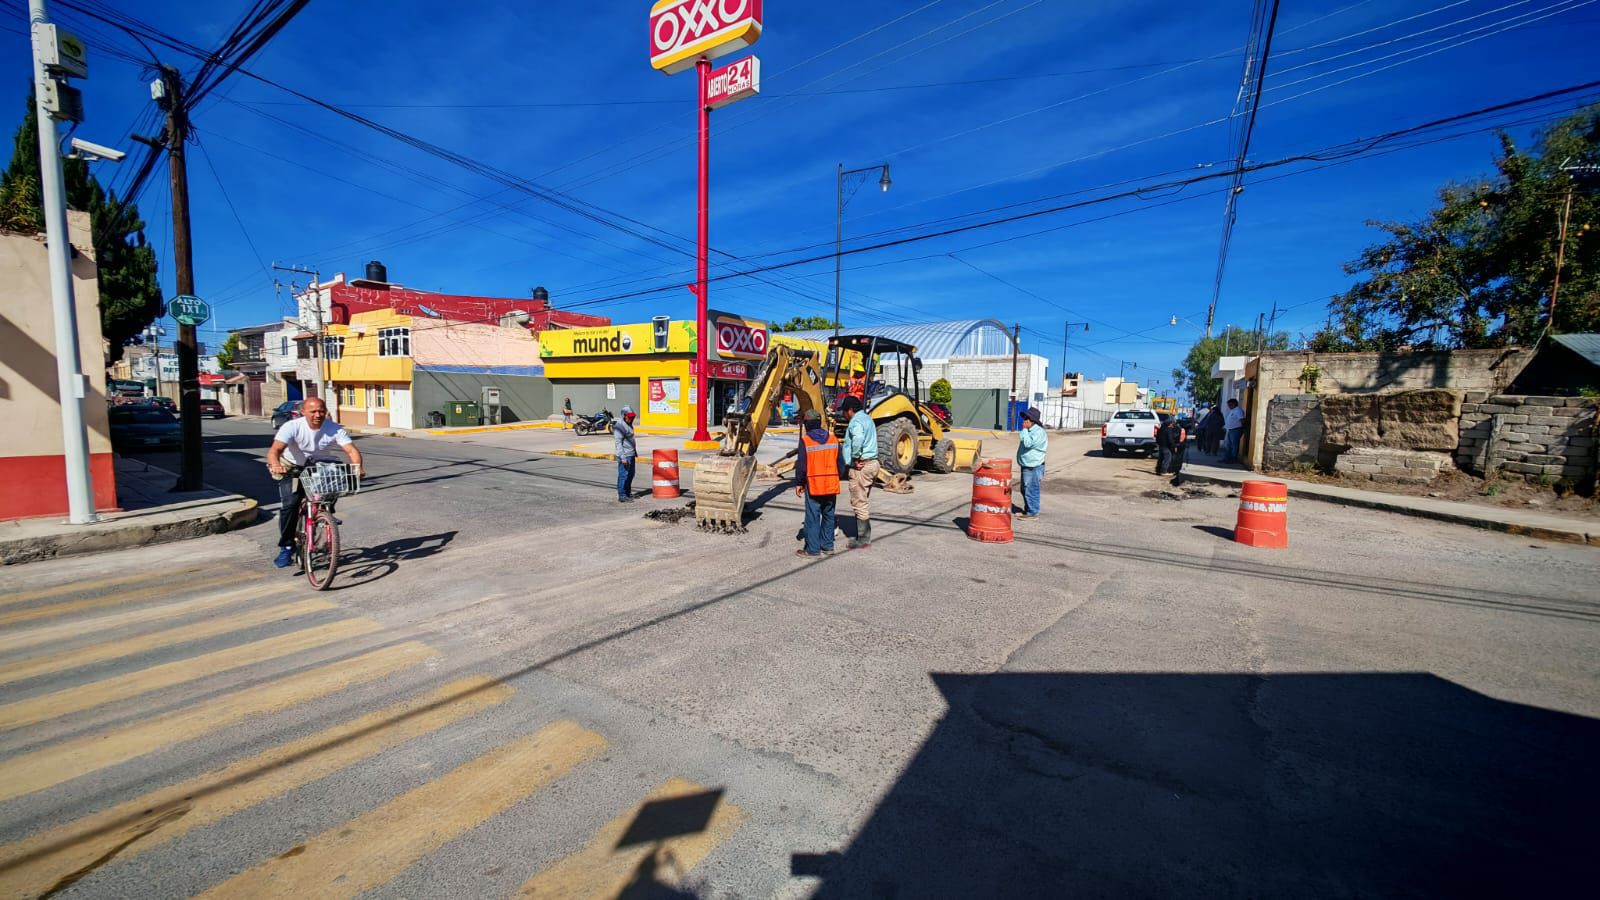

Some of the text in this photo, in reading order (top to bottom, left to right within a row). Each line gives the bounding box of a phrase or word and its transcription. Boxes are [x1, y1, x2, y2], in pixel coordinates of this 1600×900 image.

[654, 0, 747, 50] OXXO
[729, 61, 750, 85] 24
[729, 81, 750, 93] HORAS
[720, 326, 765, 352] OXXO
